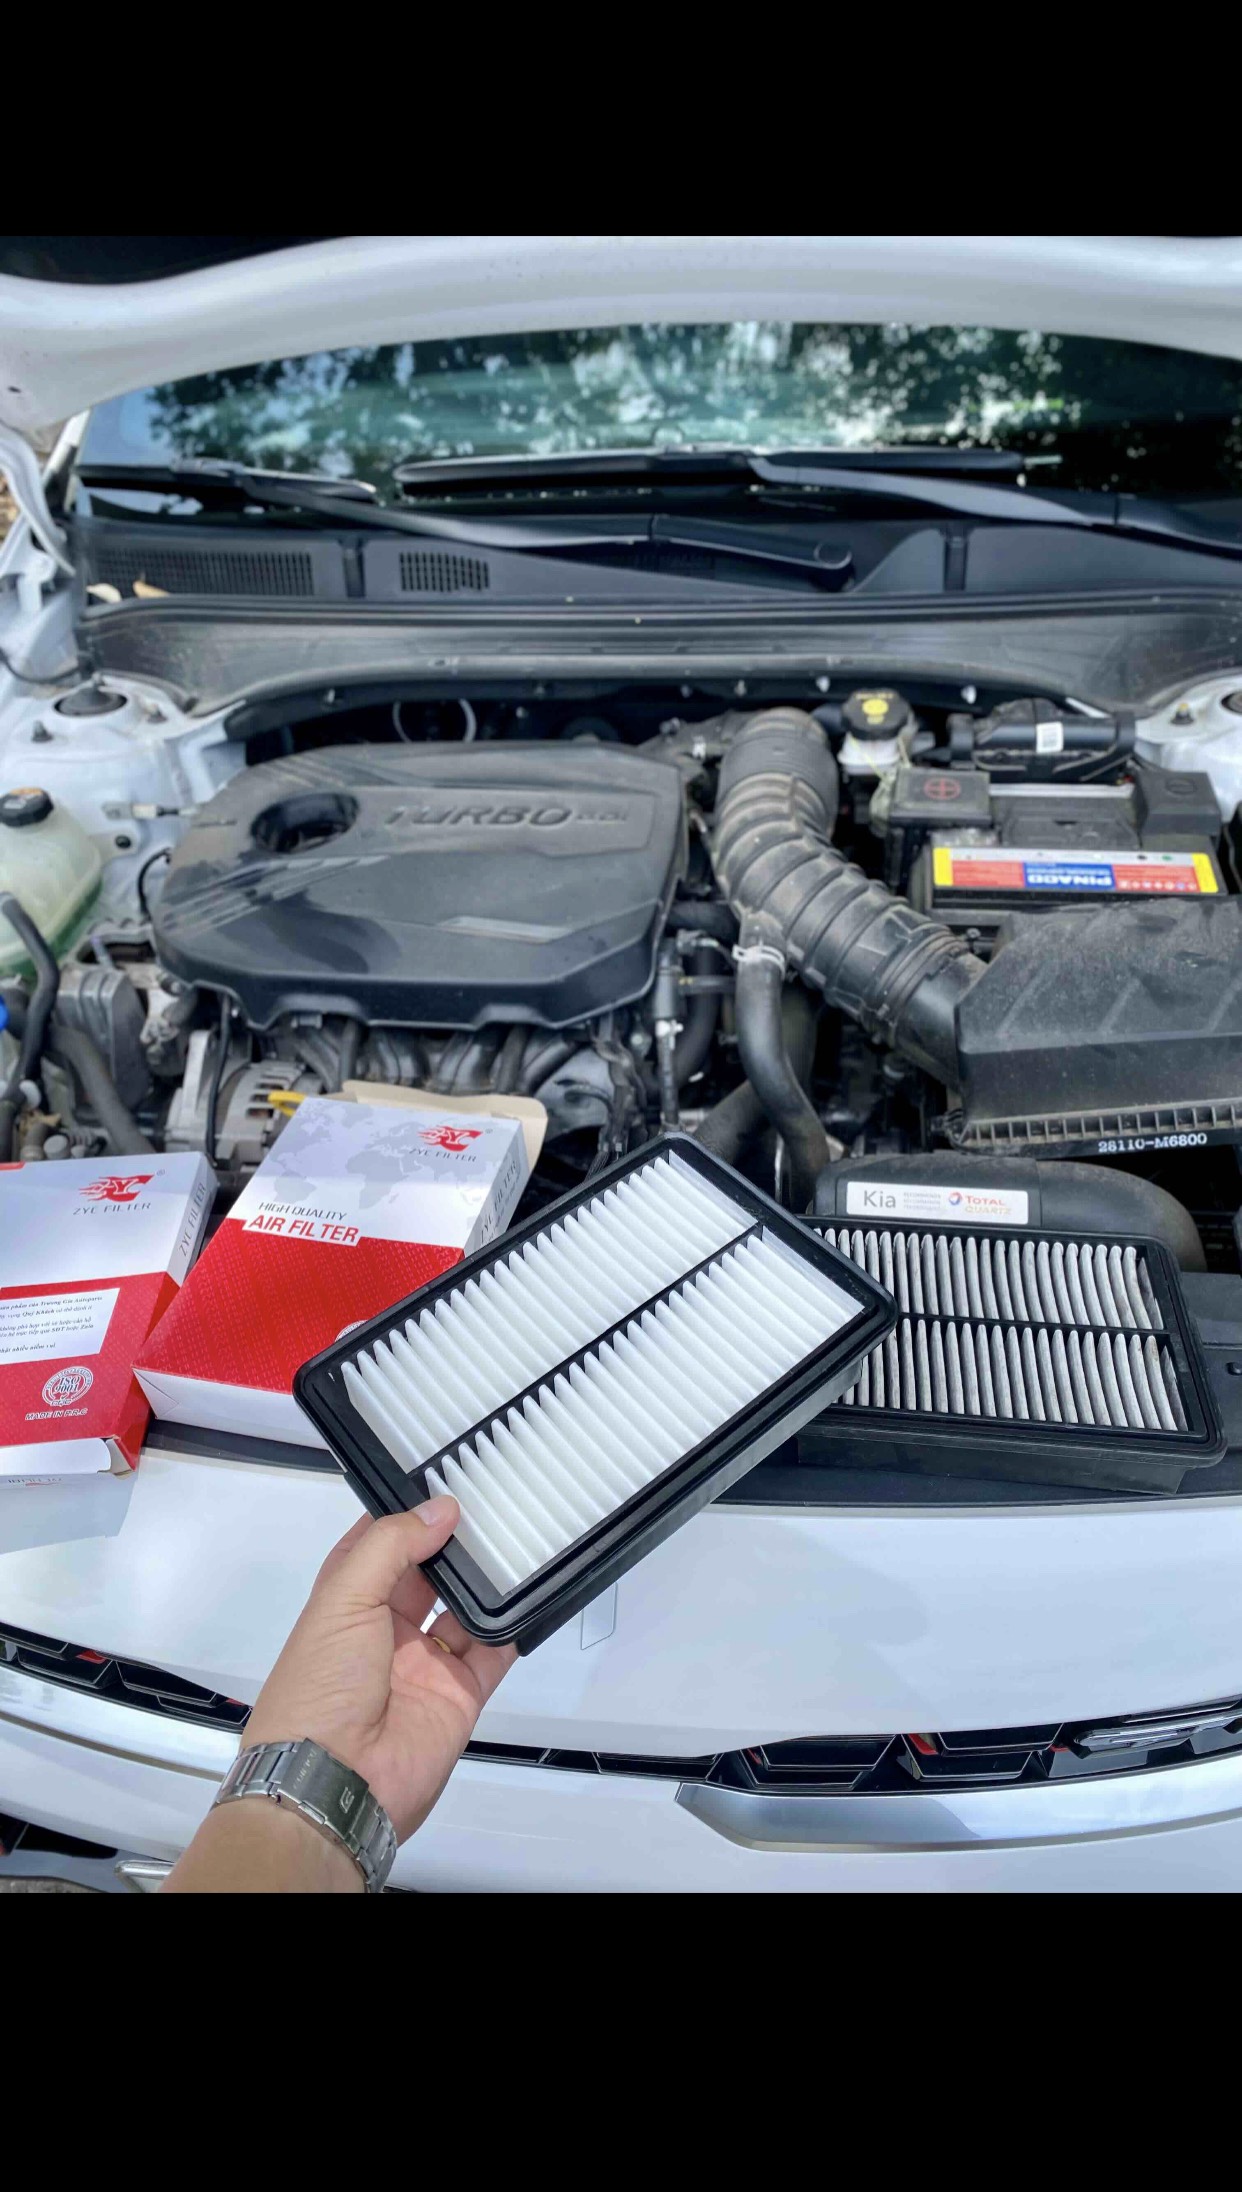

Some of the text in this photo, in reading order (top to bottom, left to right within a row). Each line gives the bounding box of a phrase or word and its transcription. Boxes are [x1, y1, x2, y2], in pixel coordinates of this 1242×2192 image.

[385, 804, 572, 828] TURBO
[1098, 1132, 1208, 1153] 28110-M6800
[436, 1151, 477, 1162] FILTER
[104, 1202, 151, 1213] FILTER
[188, 1182, 207, 1228] FILTER
[864, 1190, 896, 1208] Kia
[966, 1195, 1005, 1206] TOTAL
[259, 1202, 347, 1220] HIGH QUALITY
[249, 1214, 359, 1243] AIR FILTER
[60, 1375, 81, 1386] ISO
[25, 1411, 52, 1420] MADE
[53, 1409, 63, 1418] IN
